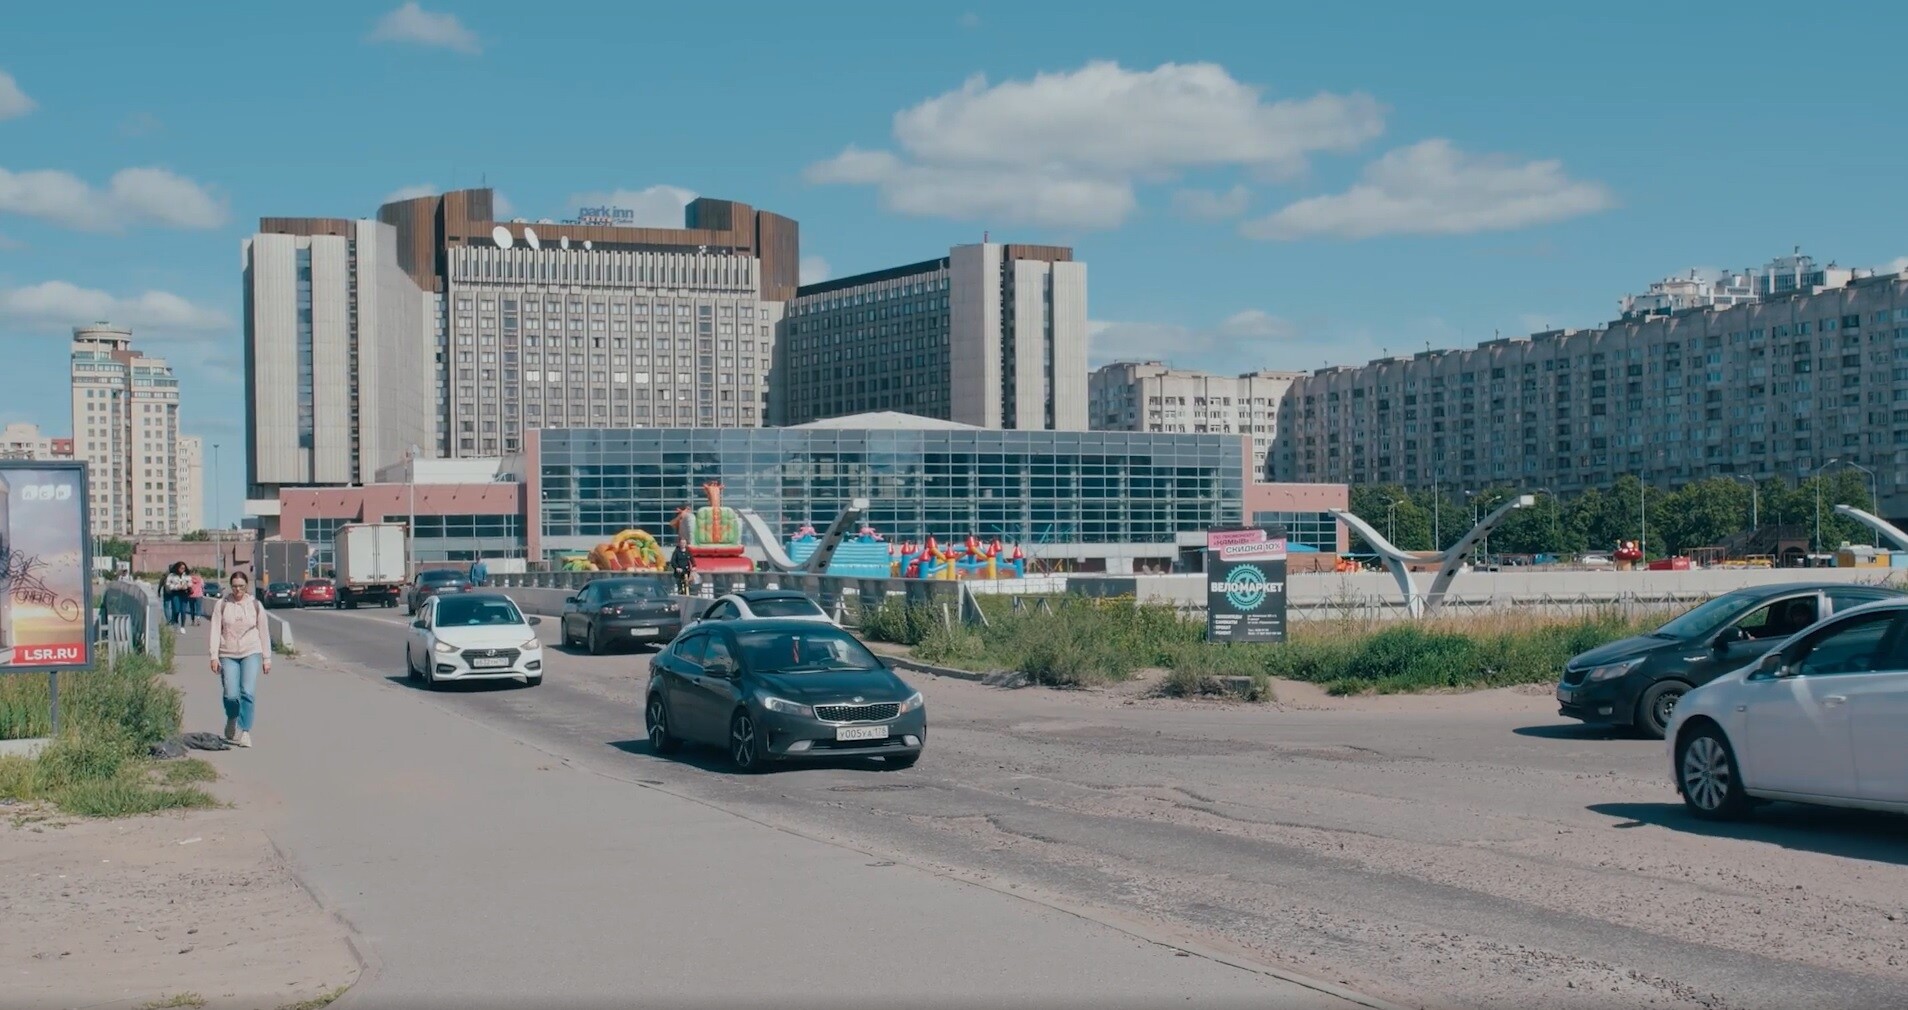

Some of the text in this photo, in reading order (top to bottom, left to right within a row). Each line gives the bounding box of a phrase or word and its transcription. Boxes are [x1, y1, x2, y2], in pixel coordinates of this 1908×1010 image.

[580, 205, 634, 218] park inn
[1225, 543, 1263, 554] СКИДКА
[1210, 582, 1284, 593] ВЕЛОМАРКЕТ
[24, 648, 78, 661] LSR.RU
